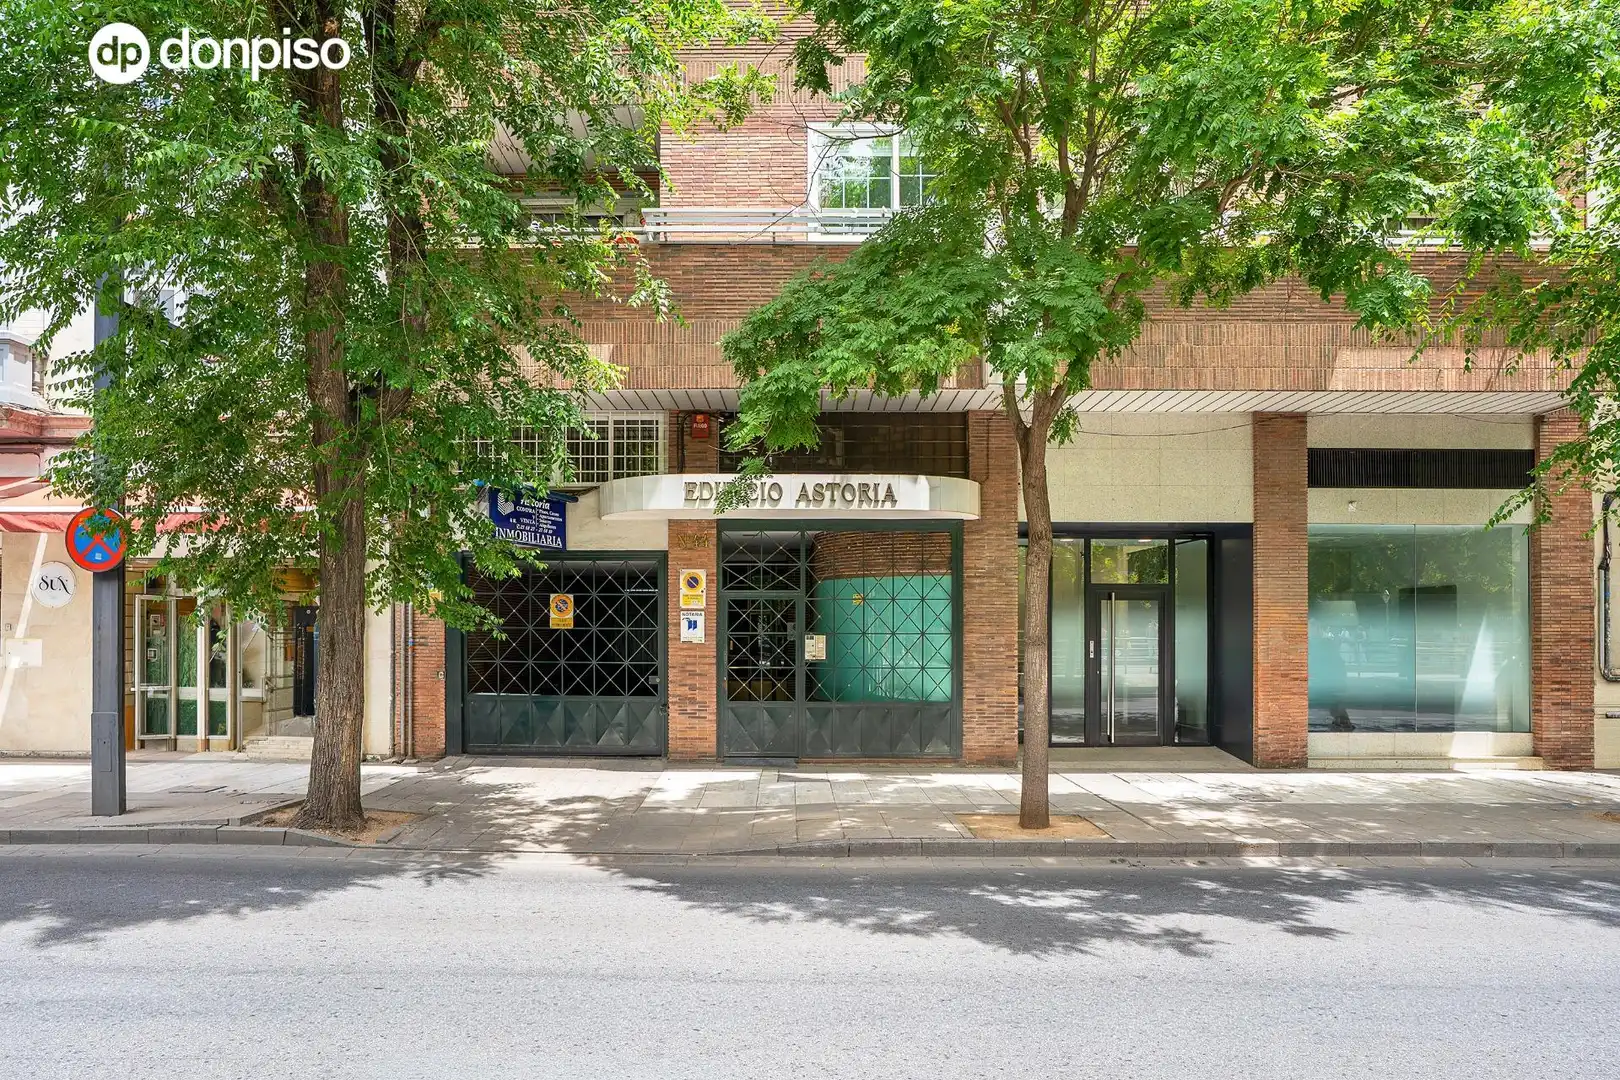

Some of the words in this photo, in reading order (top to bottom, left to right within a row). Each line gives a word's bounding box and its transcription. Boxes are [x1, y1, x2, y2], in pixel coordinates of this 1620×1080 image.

[684, 481, 783, 501] EDICIO
[796, 481, 897, 503] ASTORIA
[495, 527, 562, 547] INMOBILIARIA
